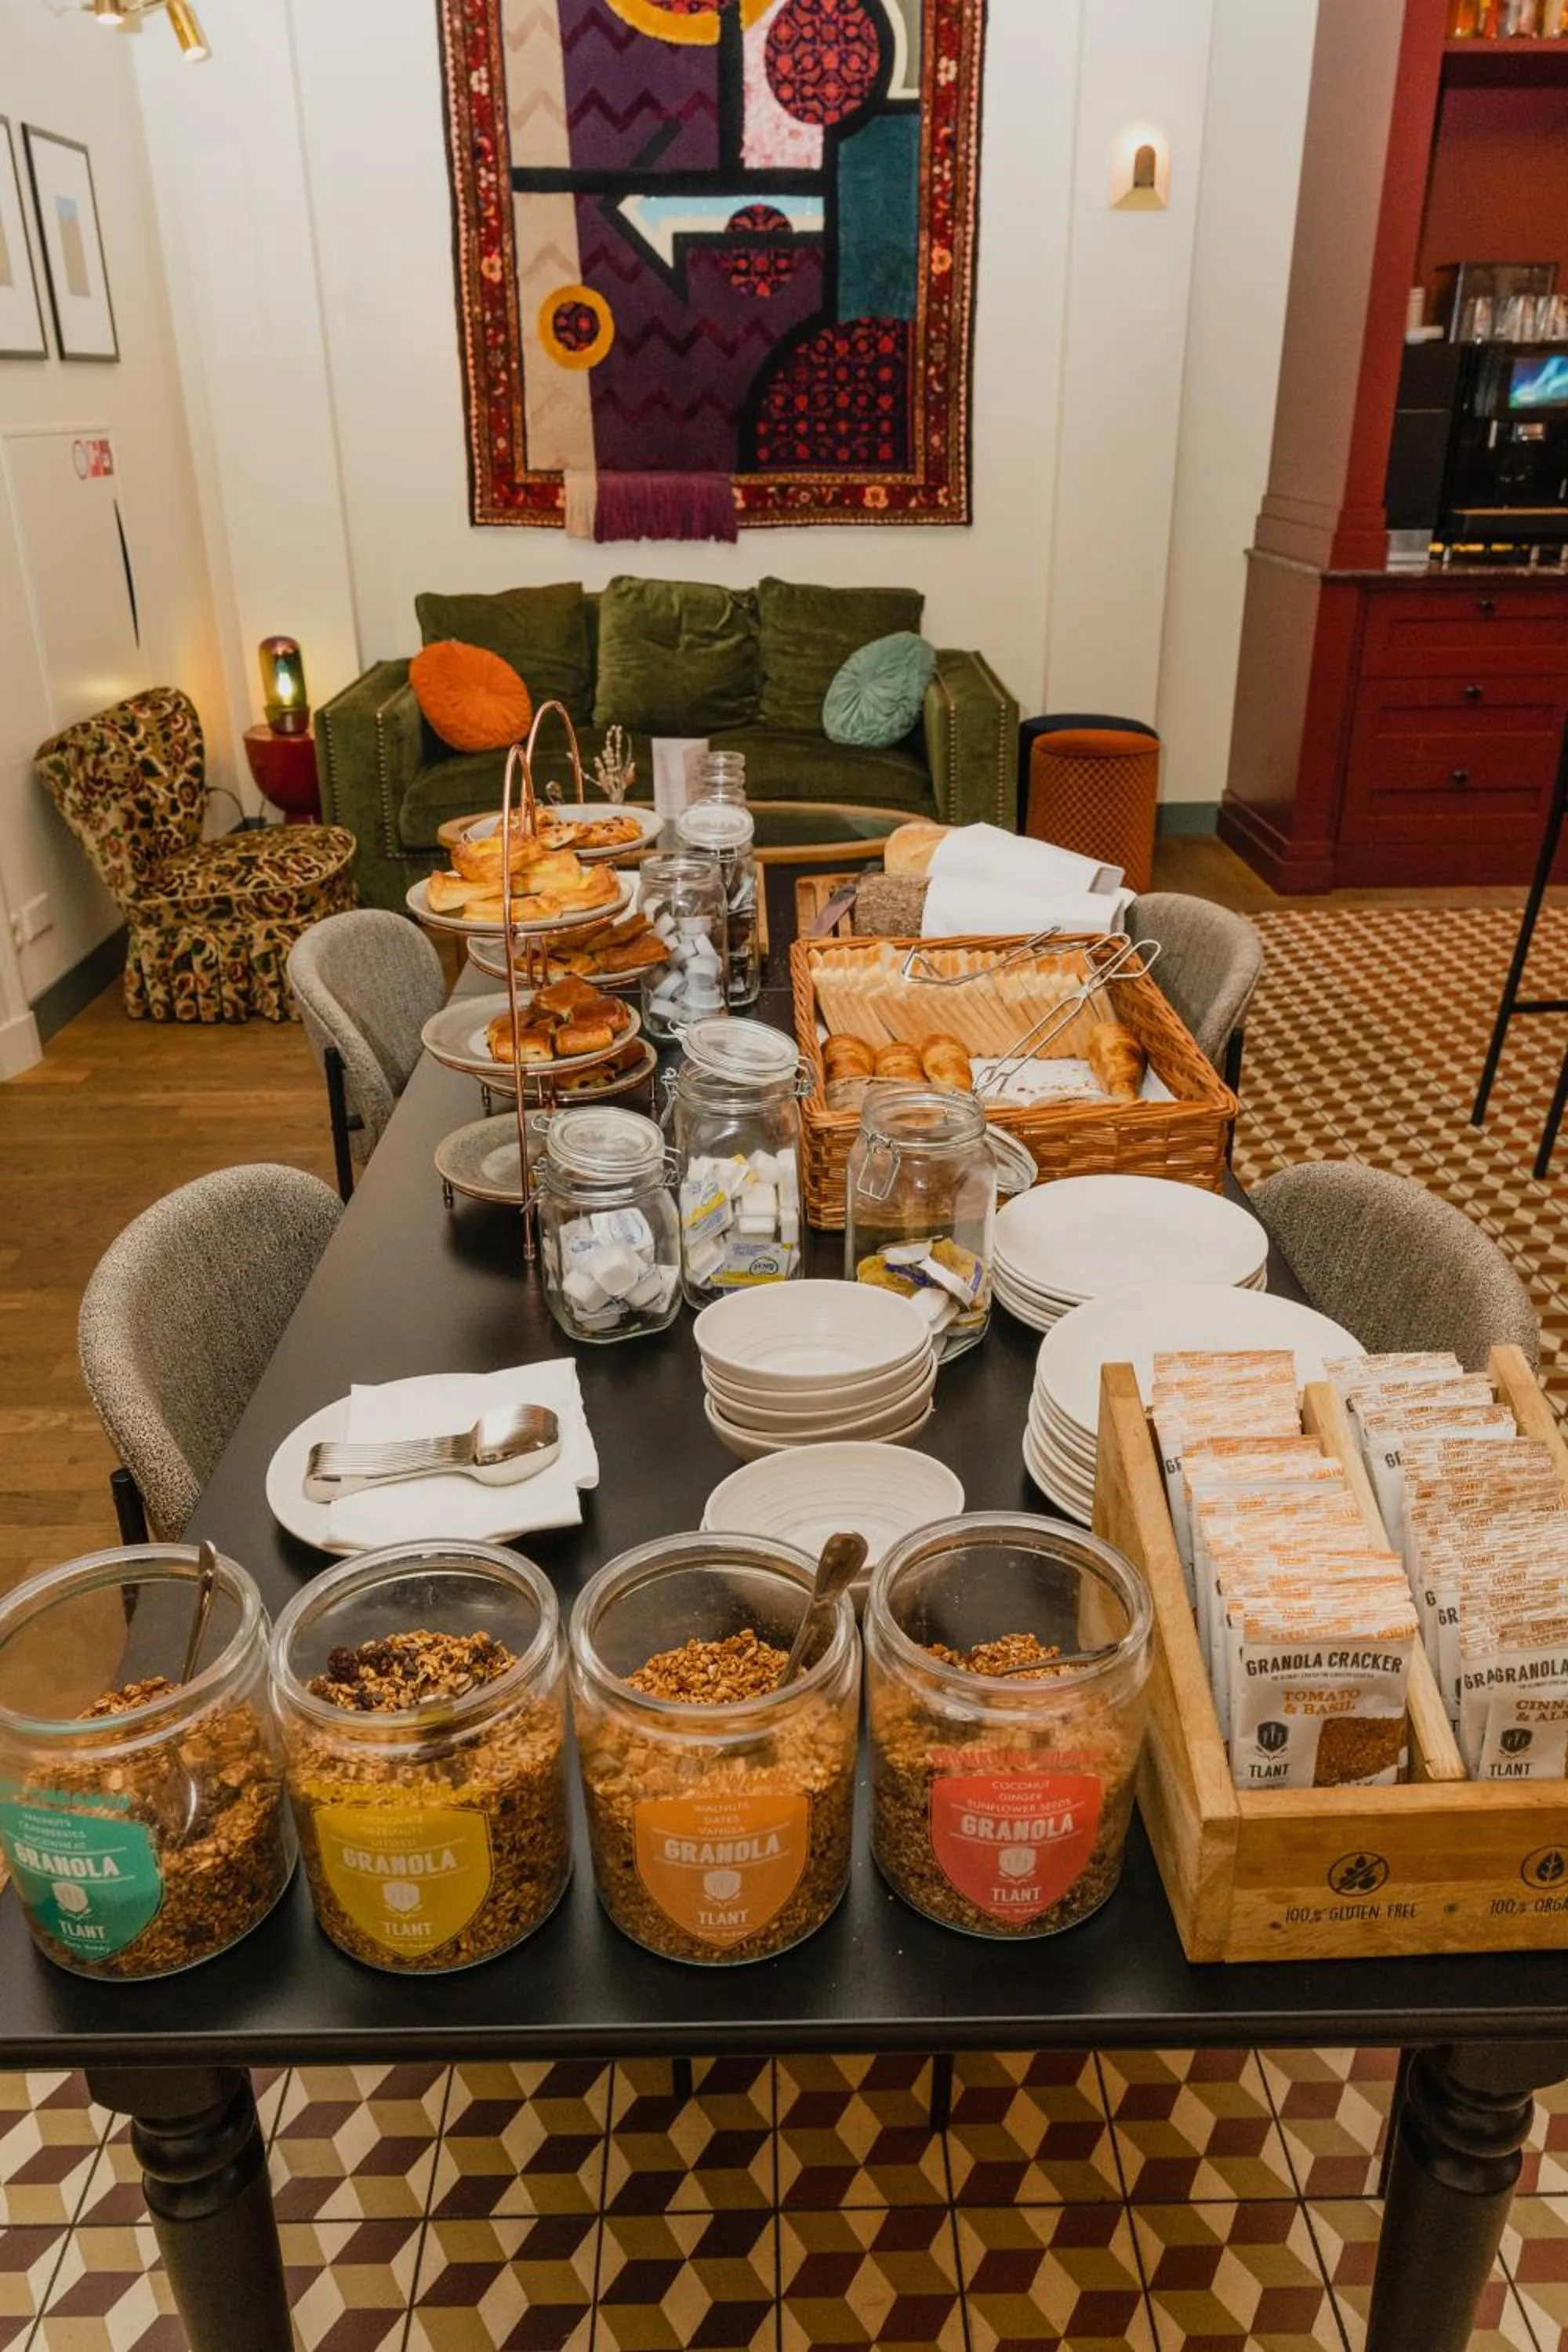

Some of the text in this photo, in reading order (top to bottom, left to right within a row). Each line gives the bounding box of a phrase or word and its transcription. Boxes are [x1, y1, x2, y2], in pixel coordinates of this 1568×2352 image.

[1247, 1651, 1403, 1676] GRANOLA CRACKER
[1283, 1689, 1361, 1702] TOMATO
[1283, 1701, 1356, 1715] & BASIL
[1249, 1763, 1290, 1778] TLANT
[1490, 1763, 1533, 1777] TLANT
[991, 1780, 1051, 1790] COCONUT
[961, 1813, 1073, 1842] GRANOLA
[665, 1833, 780, 1864] GRANOLA
[14, 1842, 120, 1878] GRANOLA
[342, 1846, 457, 1877] GRANOLA
[991, 1887, 1041, 1902] TLANT
[698, 1909, 749, 1926] TLANT
[1329, 1904, 1380, 1920] GLUTEN
[1387, 1902, 1417, 1918] FREE
[58, 1920, 105, 1938] TLANT
[383, 1922, 432, 1936] TLANT
